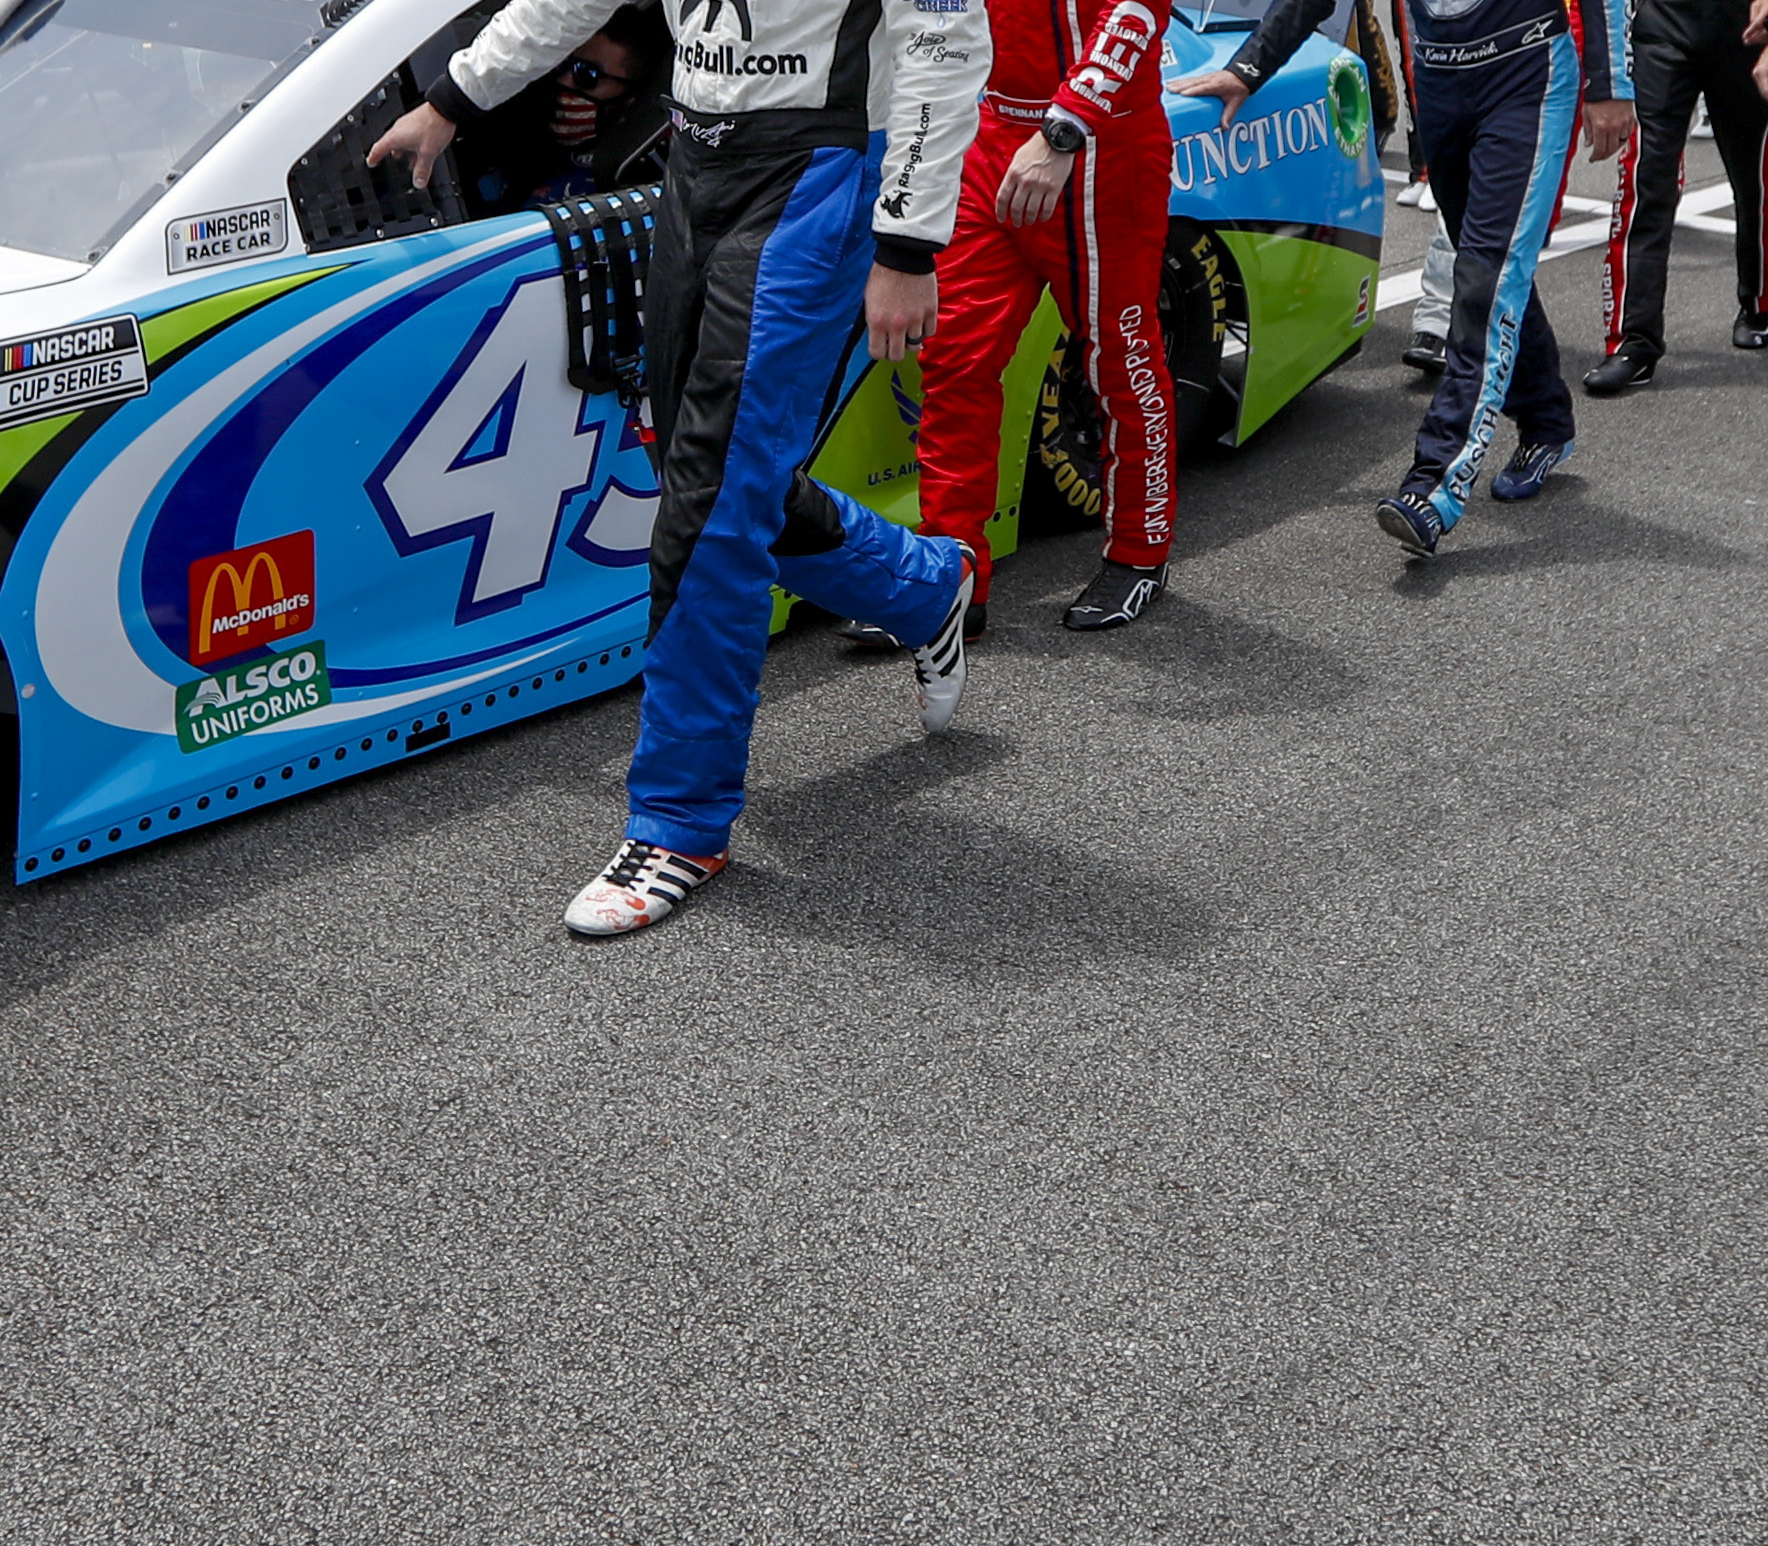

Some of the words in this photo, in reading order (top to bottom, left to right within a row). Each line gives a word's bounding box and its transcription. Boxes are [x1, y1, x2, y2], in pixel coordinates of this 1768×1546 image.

[1168, 97, 1330, 192] UNCTION
[206, 209, 271, 239] NASCAR
[186, 239, 232, 263] RACE
[236, 232, 271, 251] CAR
[1191, 233, 1227, 343] EAGLE
[32, 325, 116, 367] NASCAR
[9, 379, 49, 405] CUP
[53, 360, 123, 396] SERIES
[866, 467, 896, 487] U.S.
[211, 592, 311, 635] McDonald's
[186, 650, 318, 718] ALSCO
[190, 682, 320, 745] UNIFORMS
